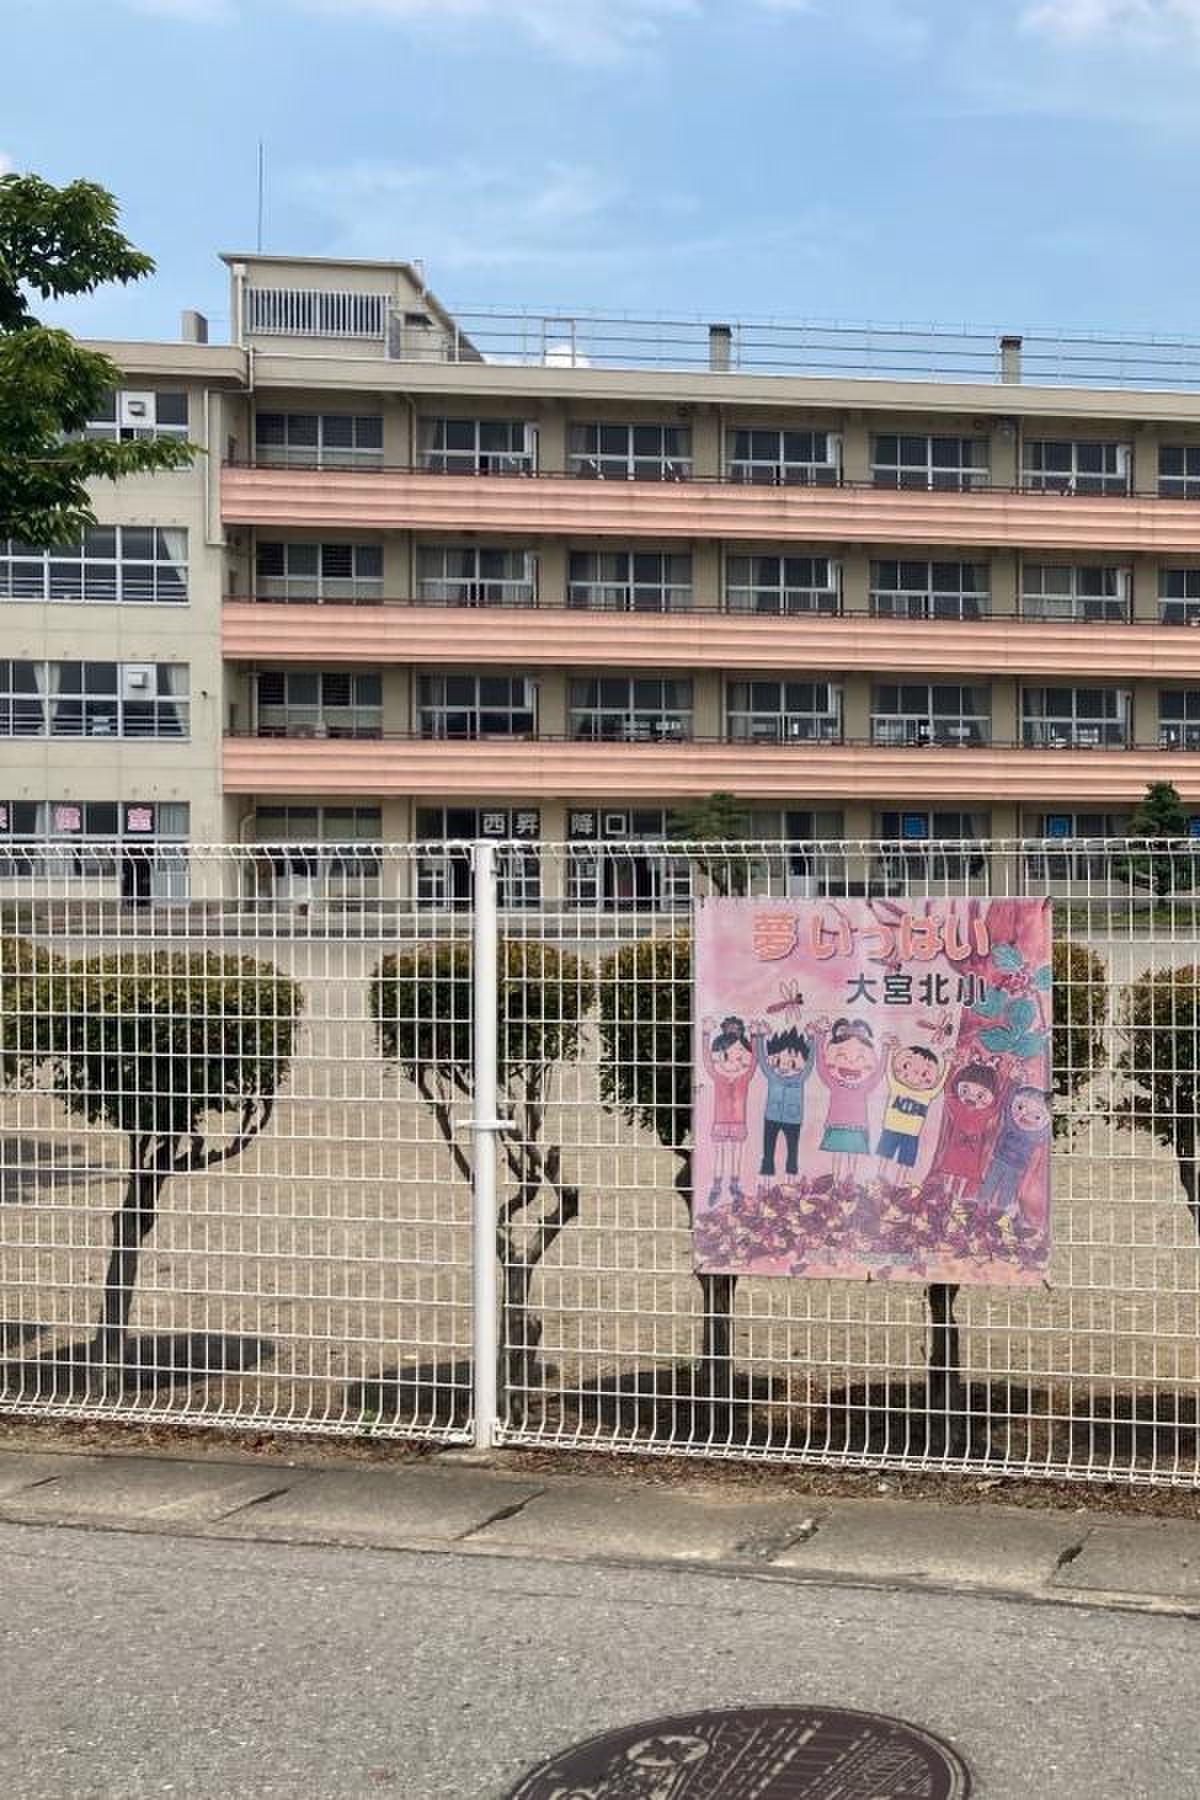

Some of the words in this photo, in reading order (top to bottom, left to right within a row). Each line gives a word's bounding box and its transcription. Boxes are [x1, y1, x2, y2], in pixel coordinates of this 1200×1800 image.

[482, 813, 626, 834] 西昇降口
[847, 973, 987, 1007] 大宮北小
